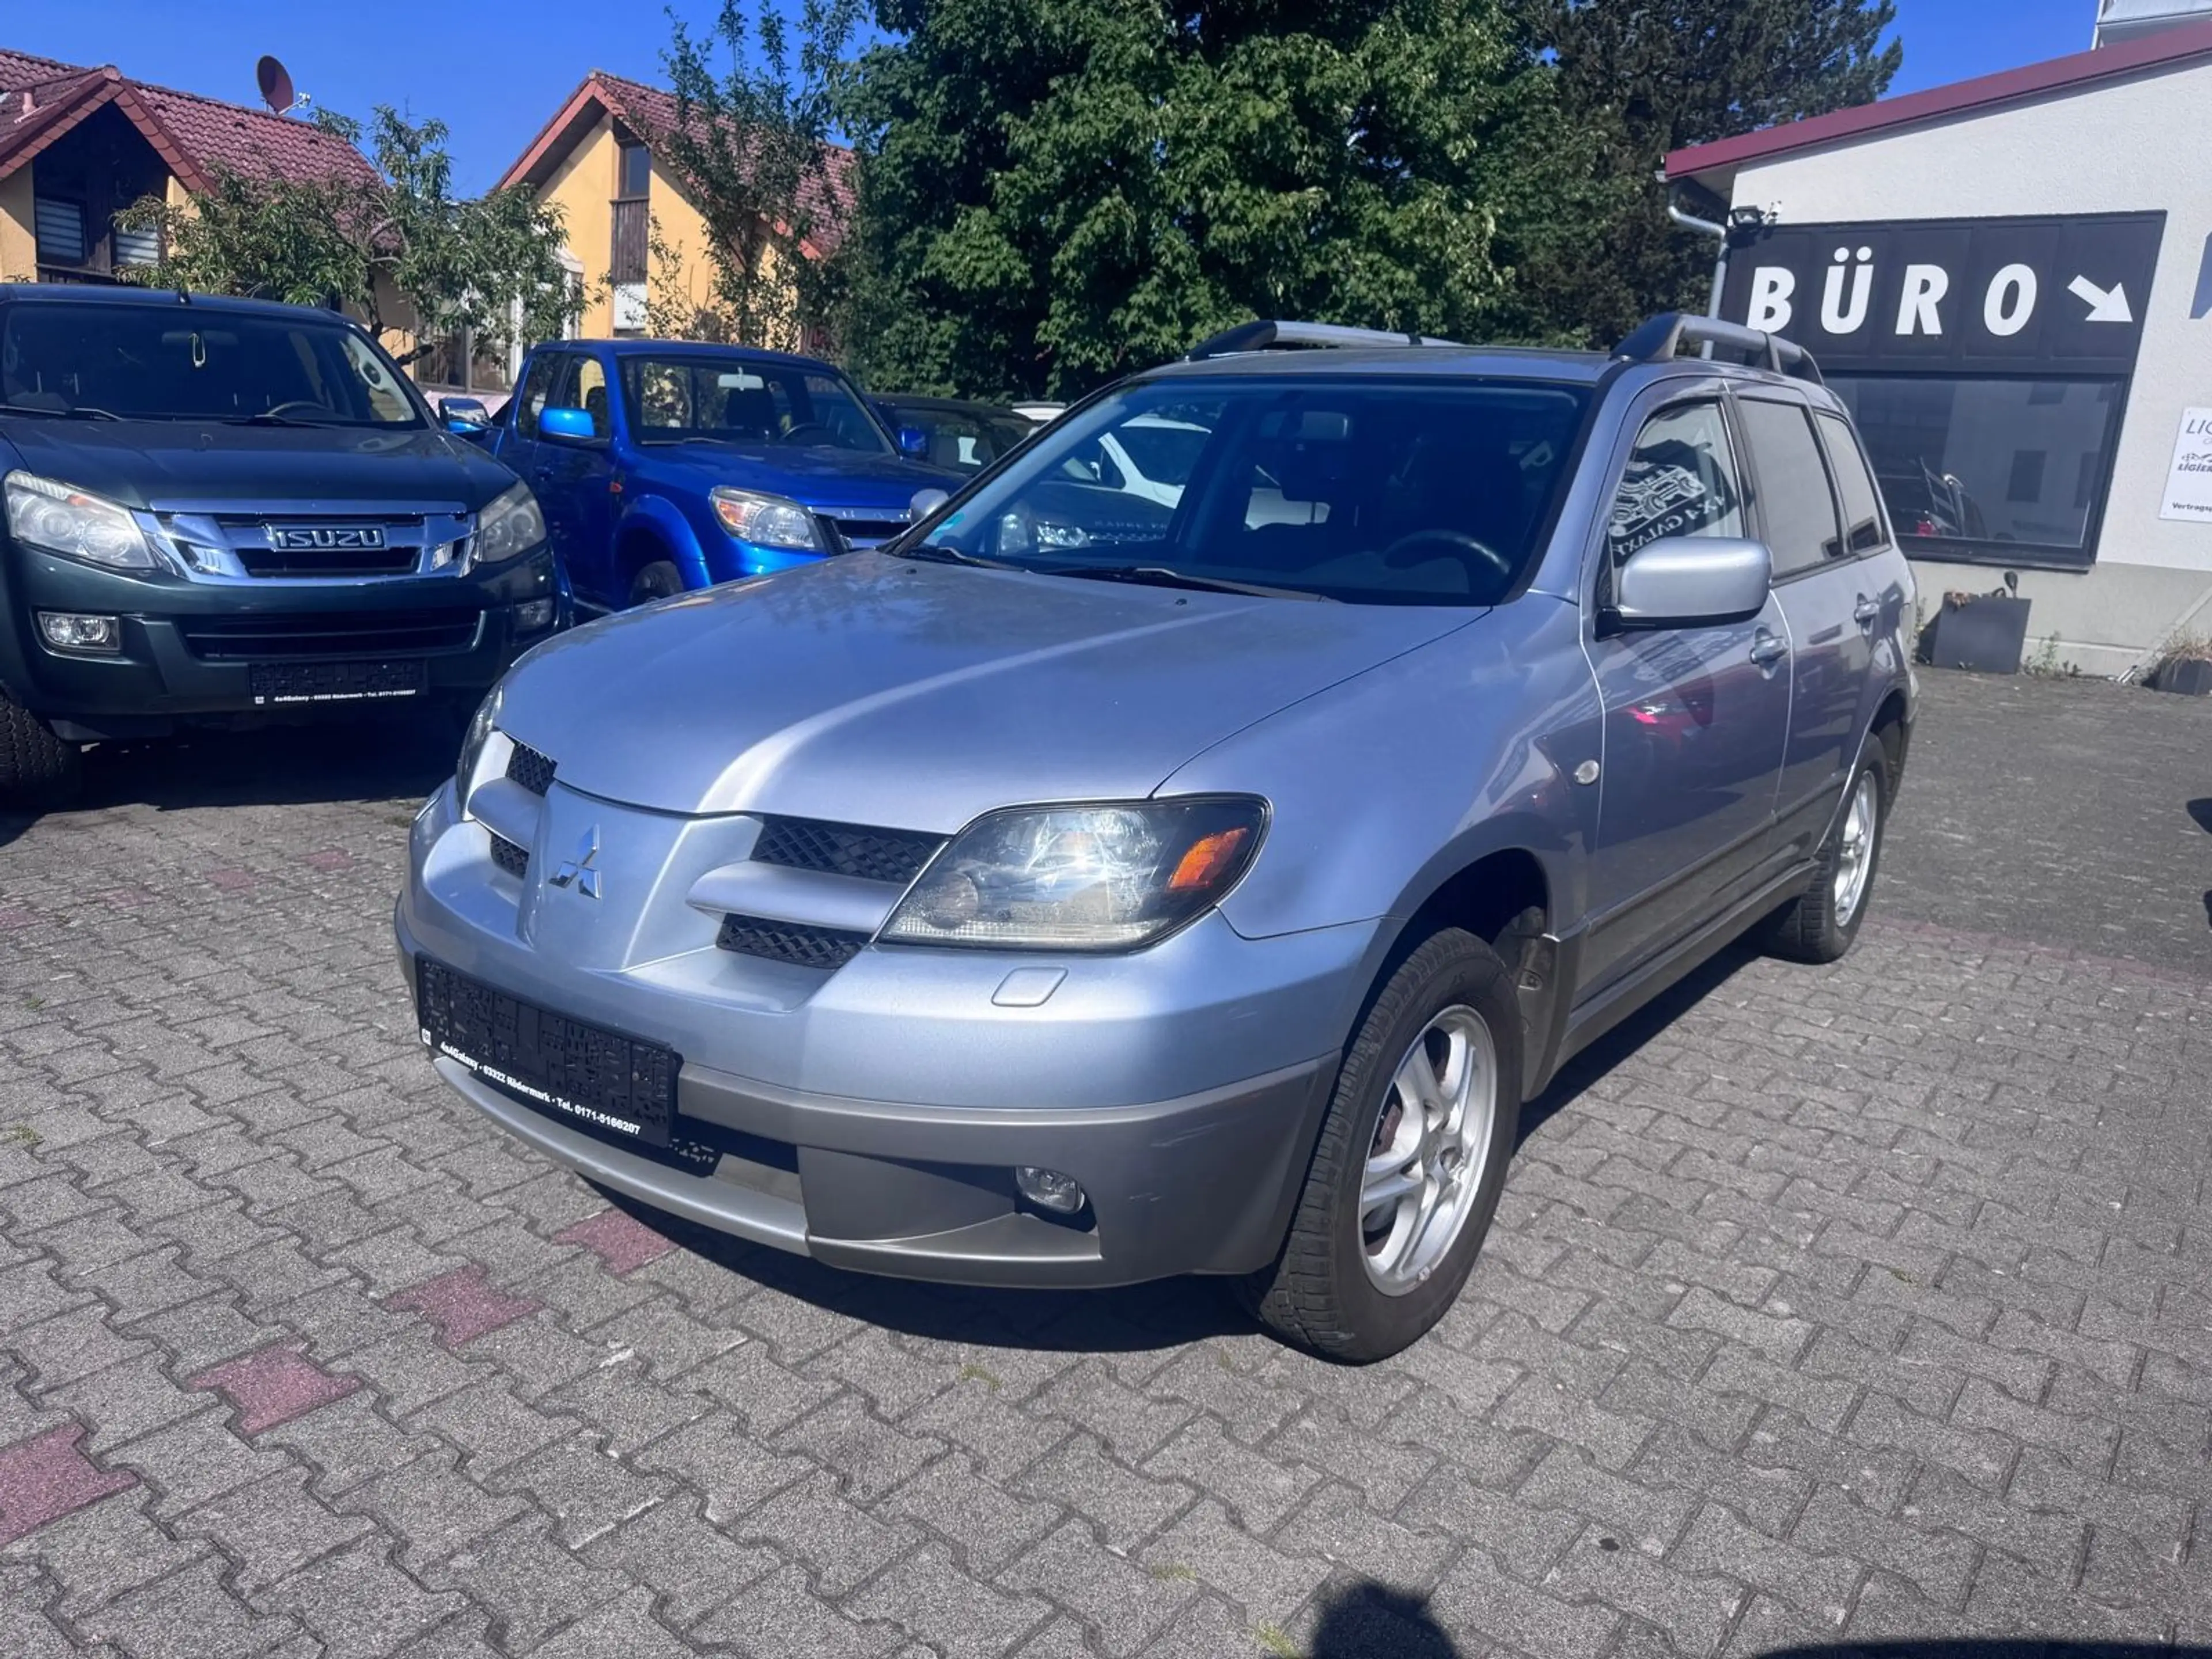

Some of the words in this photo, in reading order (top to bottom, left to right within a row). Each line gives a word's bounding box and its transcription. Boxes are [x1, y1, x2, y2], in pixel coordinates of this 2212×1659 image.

[1747, 247, 2037, 336] BÜRO
[276, 529, 383, 548] ISUZU
[556, 1096, 573, 1113] Tel.
